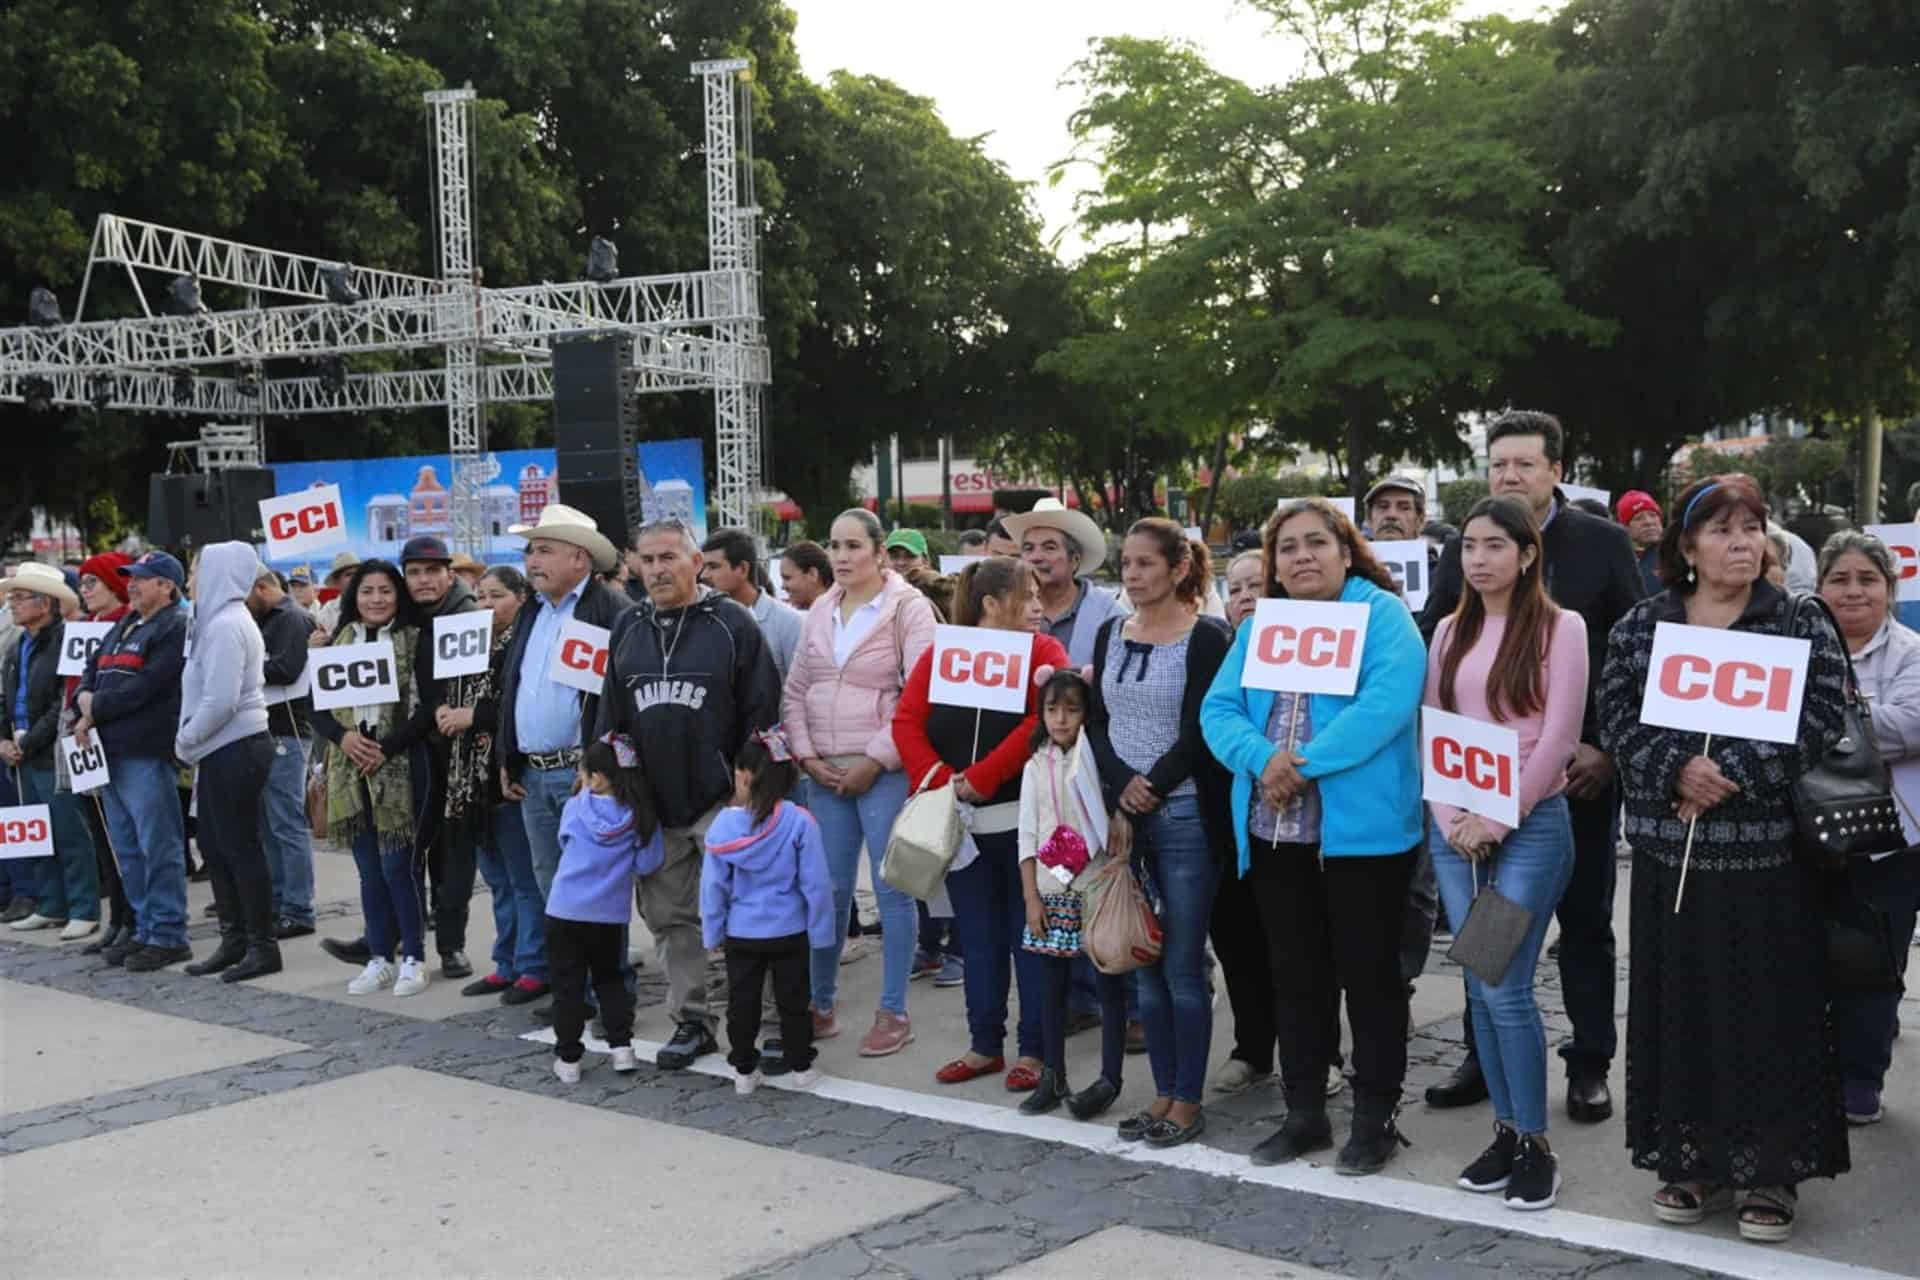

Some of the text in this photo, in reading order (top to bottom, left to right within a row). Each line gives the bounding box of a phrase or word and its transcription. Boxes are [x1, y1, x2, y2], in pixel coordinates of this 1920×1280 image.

[270, 502, 338, 540] CCI
[67, 637, 101, 659] CC
[438, 628, 488, 660] CCI
[561, 639, 609, 677] CC
[1257, 624, 1357, 668] CCI
[317, 659, 391, 691] CCI
[939, 648, 1021, 689] CCI
[1659, 654, 1792, 712] CCI
[634, 681, 707, 712] RAIDERS
[70, 744, 104, 776] CCI
[1431, 736, 1511, 797] CCI
